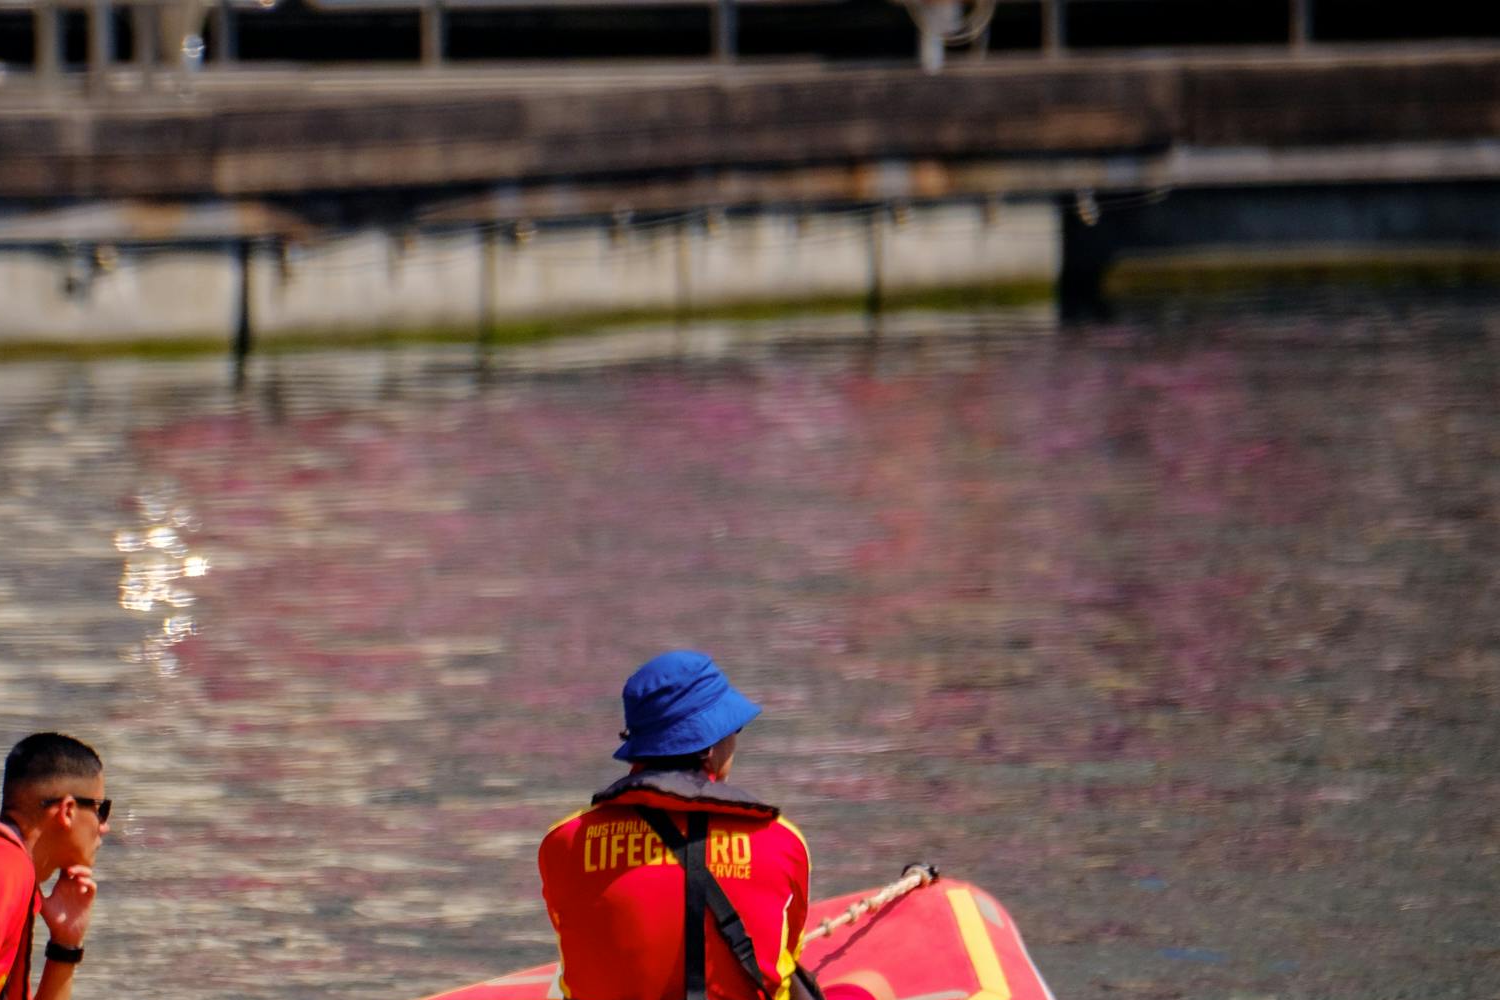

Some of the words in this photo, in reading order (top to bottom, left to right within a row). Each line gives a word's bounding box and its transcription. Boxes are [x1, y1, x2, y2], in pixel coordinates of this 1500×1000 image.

[586, 819, 652, 839] AUSTRALIA
[584, 830, 751, 872] LIFEGRD
[709, 863, 751, 880] ERVICE
